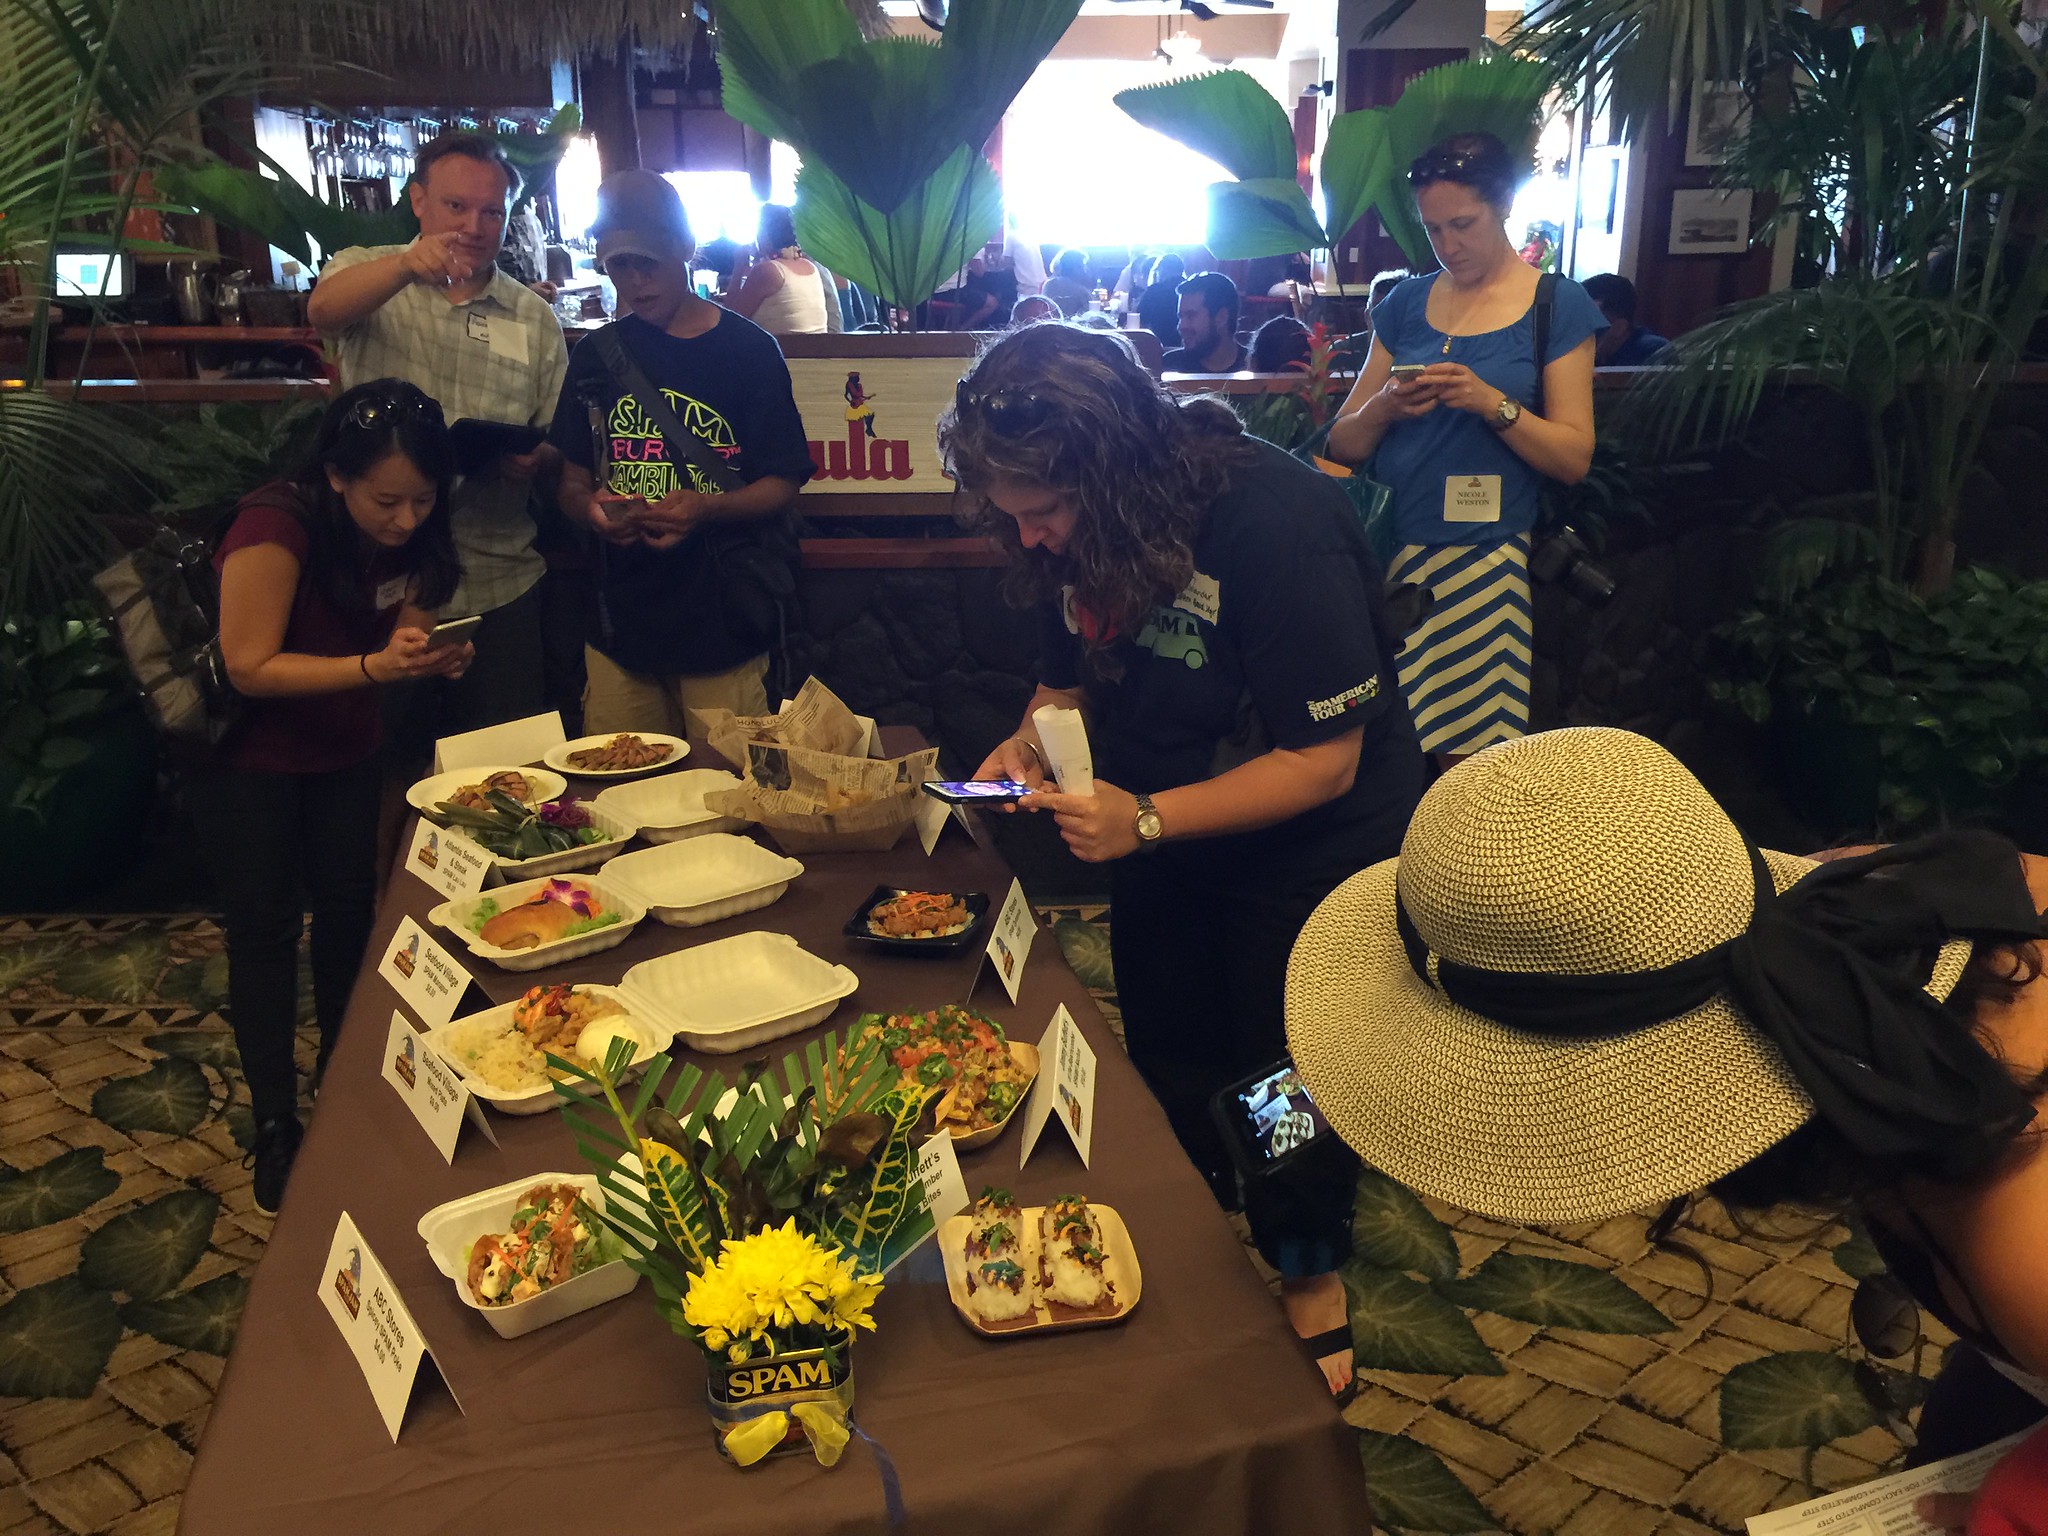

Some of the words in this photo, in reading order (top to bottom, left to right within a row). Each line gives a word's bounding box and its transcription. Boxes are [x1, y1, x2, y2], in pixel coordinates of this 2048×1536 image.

[806, 418, 914, 481] ula
[1307, 673, 1378, 713] SPAMERICAN
[1310, 703, 1346, 722] TOUR
[462, 850, 483, 869] Seafood
[425, 947, 444, 972] Seafood
[442, 965, 459, 988] Village
[422, 1051, 443, 1082] Seafood
[442, 1073, 459, 1102] Village
[922, 1188, 942, 1208] Bites
[373, 1287, 387, 1315] ABC
[386, 1308, 405, 1348] Stores
[379, 1324, 393, 1353] SPAM
[390, 1347, 402, 1373] Poke
[728, 1359, 832, 1397] SPAM
[1882, 1489, 1903, 1502] EACH
[1904, 1481, 1920, 1492] FOR
[1801, 1506, 1820, 1517] STEP
[1835, 1497, 1881, 1521] COMPLETED
[1816, 1517, 1835, 1529] STEP
